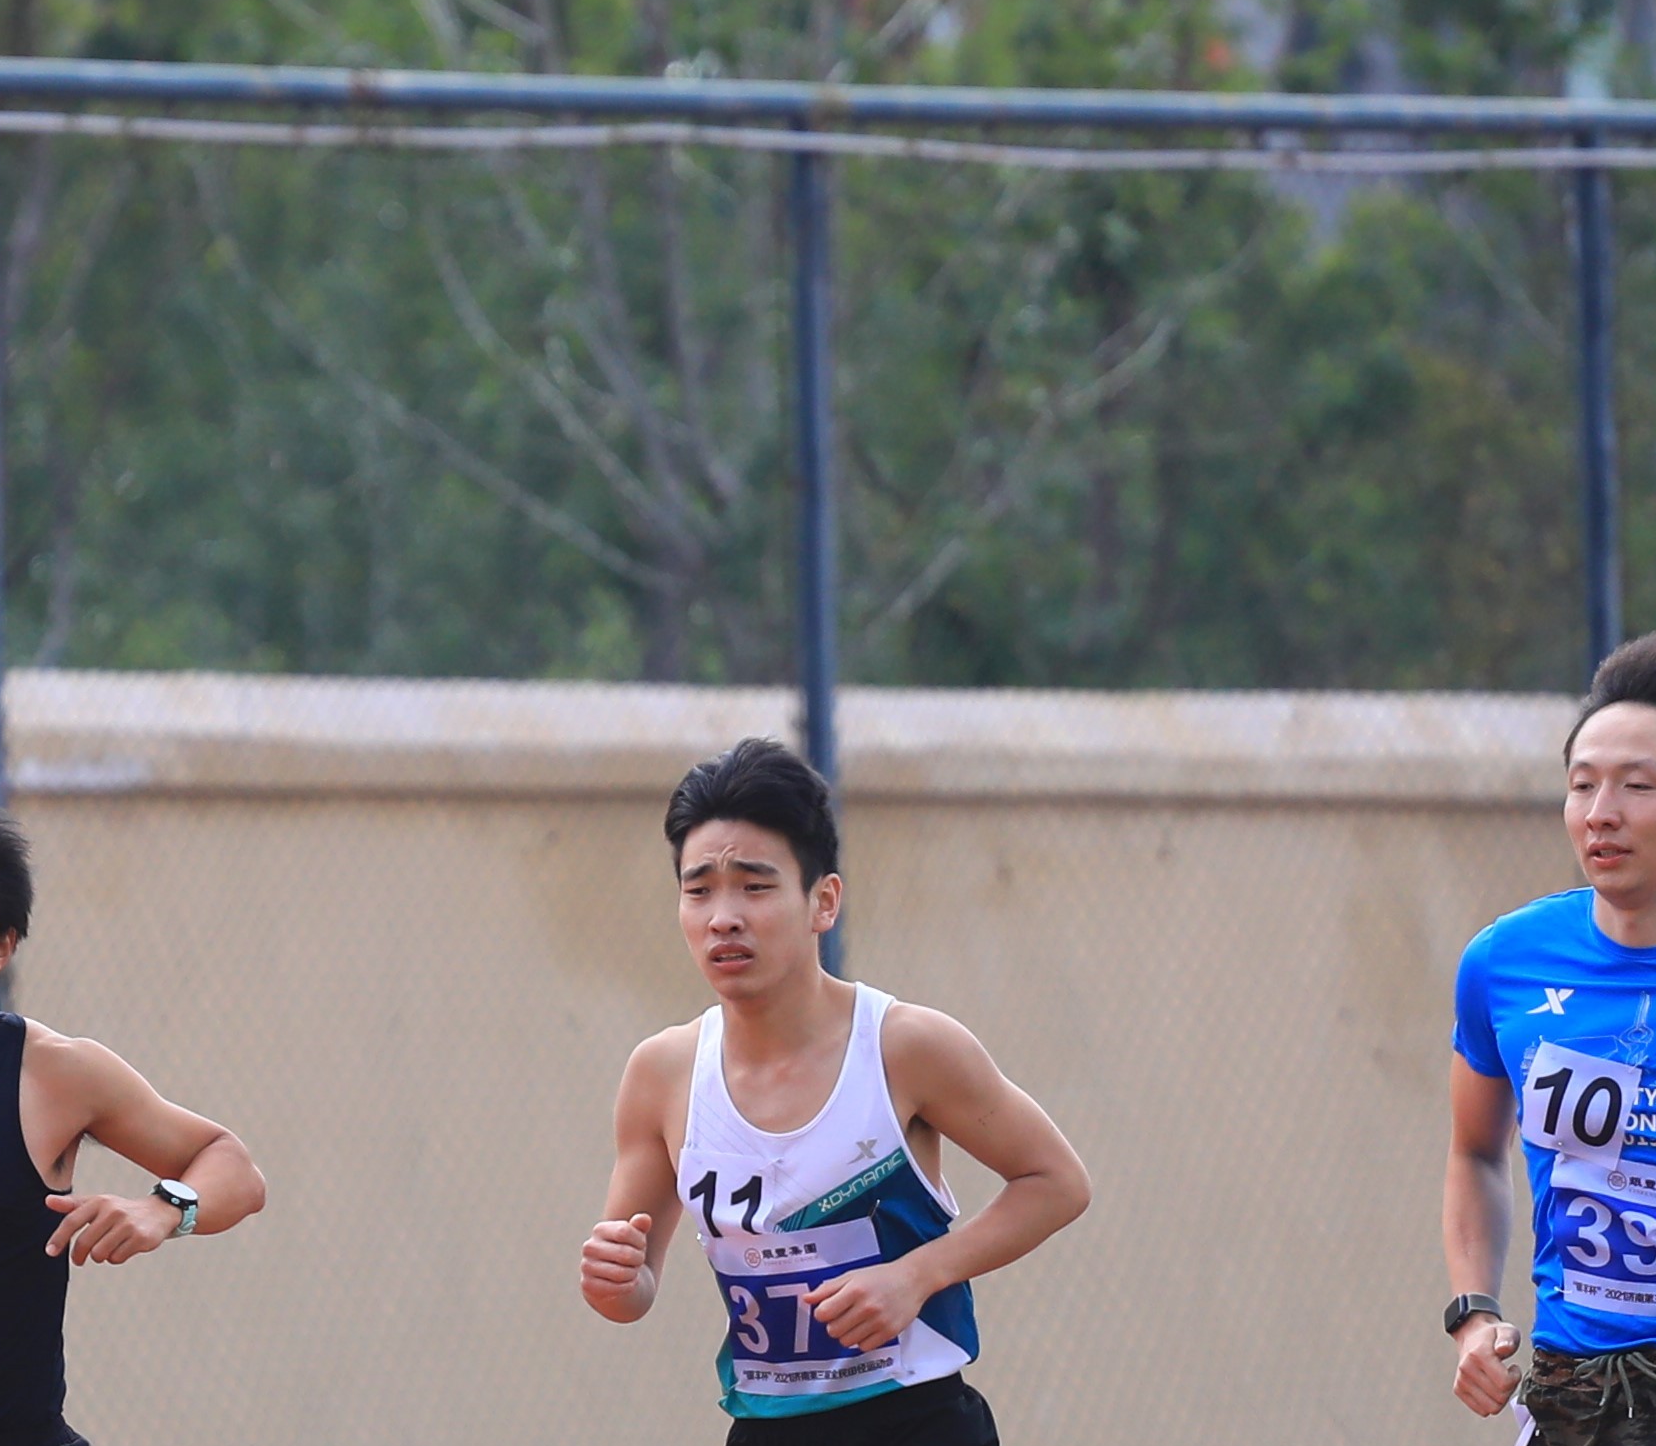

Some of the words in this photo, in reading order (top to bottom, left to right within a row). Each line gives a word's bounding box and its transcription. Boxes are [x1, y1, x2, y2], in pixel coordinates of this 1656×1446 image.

[1533, 1067, 1622, 1147] 10
[690, 1170, 763, 1238] 11
[729, 1282, 860, 1354] 37
